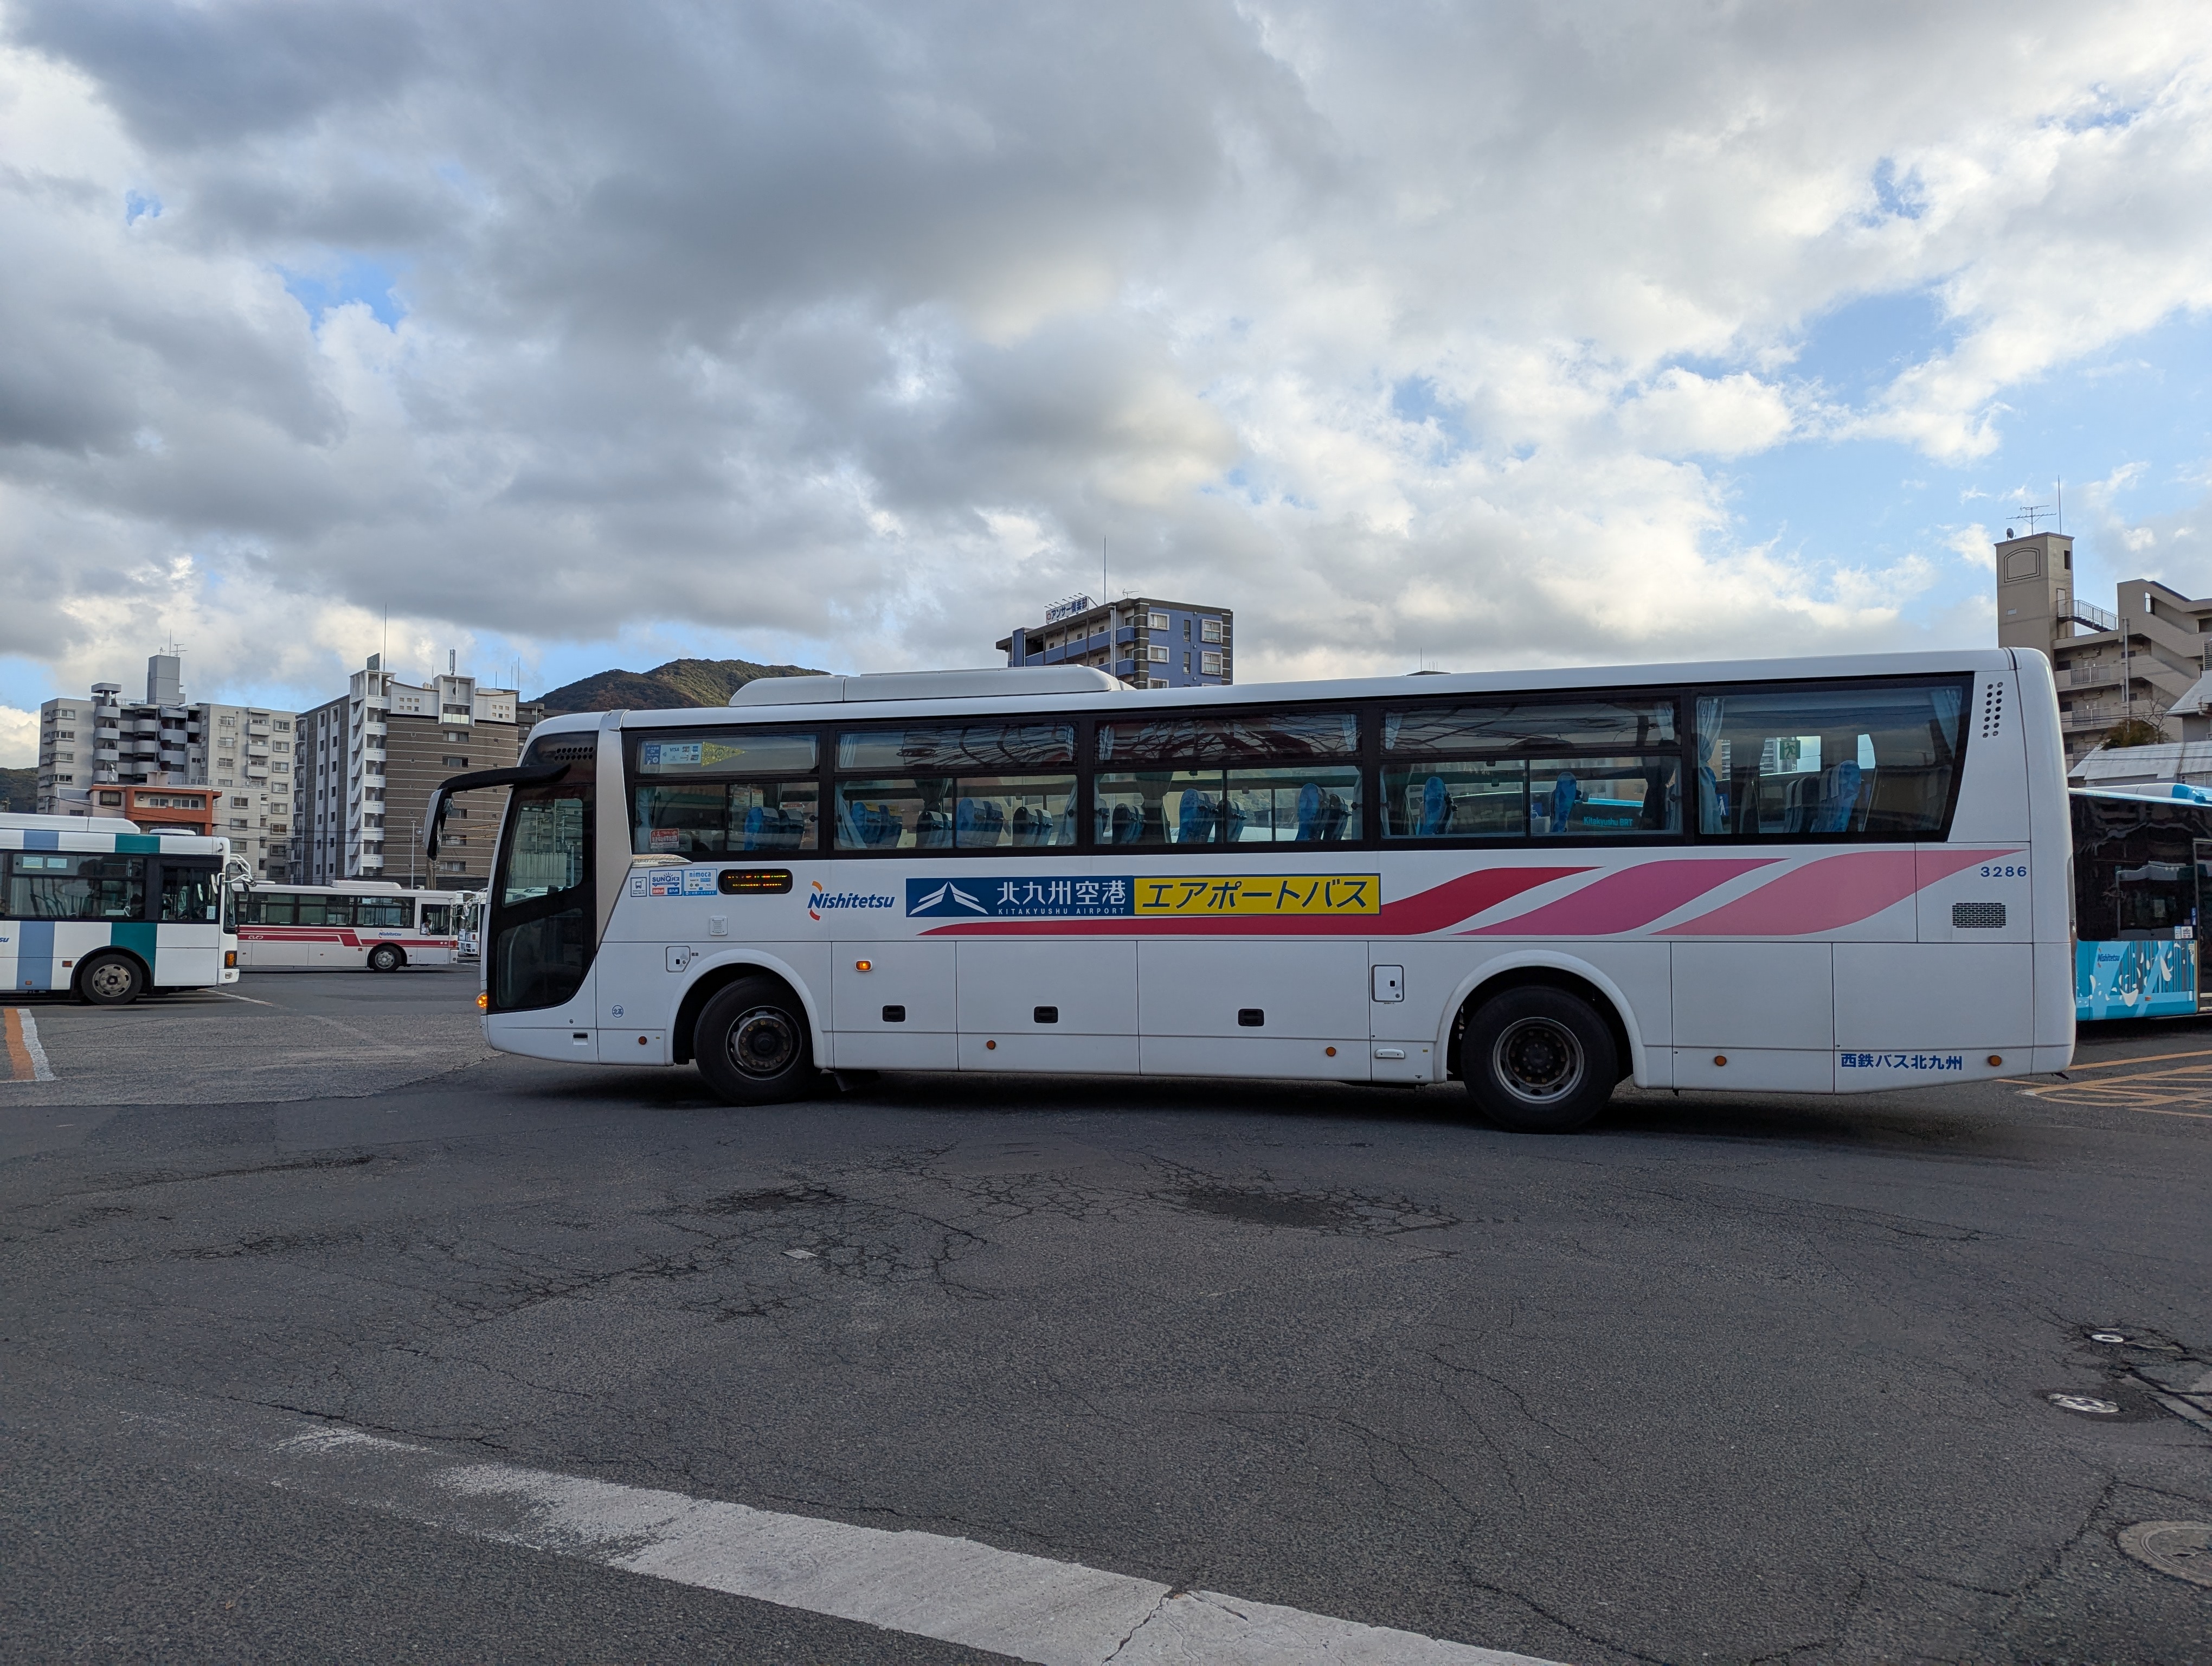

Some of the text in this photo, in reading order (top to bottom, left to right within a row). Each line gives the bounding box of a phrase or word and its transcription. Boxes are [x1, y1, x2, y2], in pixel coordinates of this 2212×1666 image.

[1051, 598, 1087, 620] アンサー倶楽部
[1584, 816, 1633, 826] Kitakyushu BRT
[1980, 866, 2027, 877] 3286
[807, 893, 896, 909] Nishitetsu
[997, 880, 1126, 905] 北九州空港
[1142, 879, 1368, 909] エアポートバス
[2097, 953, 2120, 962] Nishitetsu
[1841, 1053, 1962, 1071] 西鉄バス北九州
